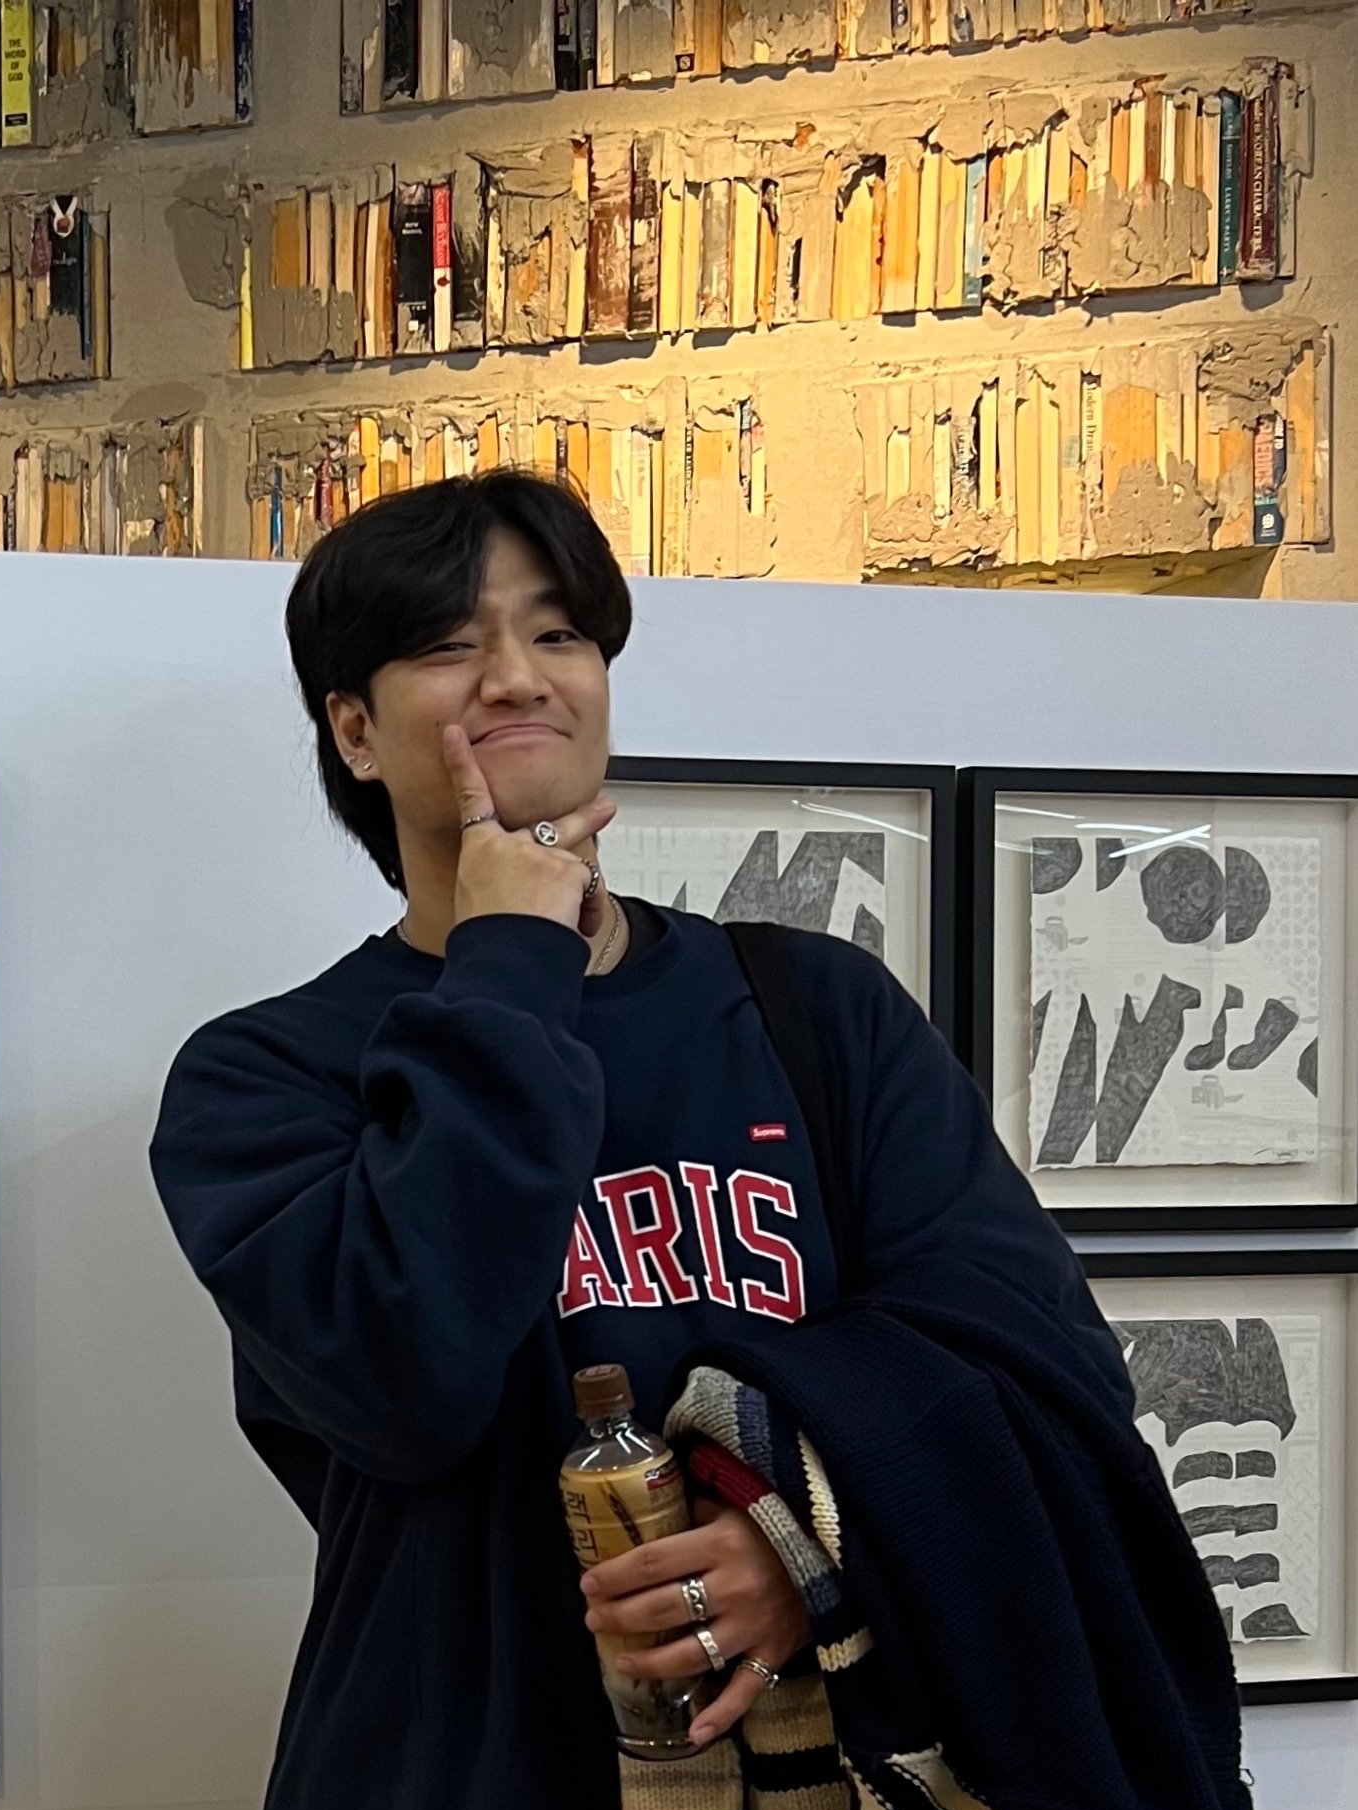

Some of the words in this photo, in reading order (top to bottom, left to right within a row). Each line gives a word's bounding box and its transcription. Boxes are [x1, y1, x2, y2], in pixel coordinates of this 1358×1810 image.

[8, 38, 22, 48] THE
[4, 49, 27, 60] WORD
[10, 61, 20, 71] OF
[7, 72, 24, 83] GOD
[1253, 134, 1263, 180] KOREAN
[1252, 181, 1263, 252] CHARACTERS
